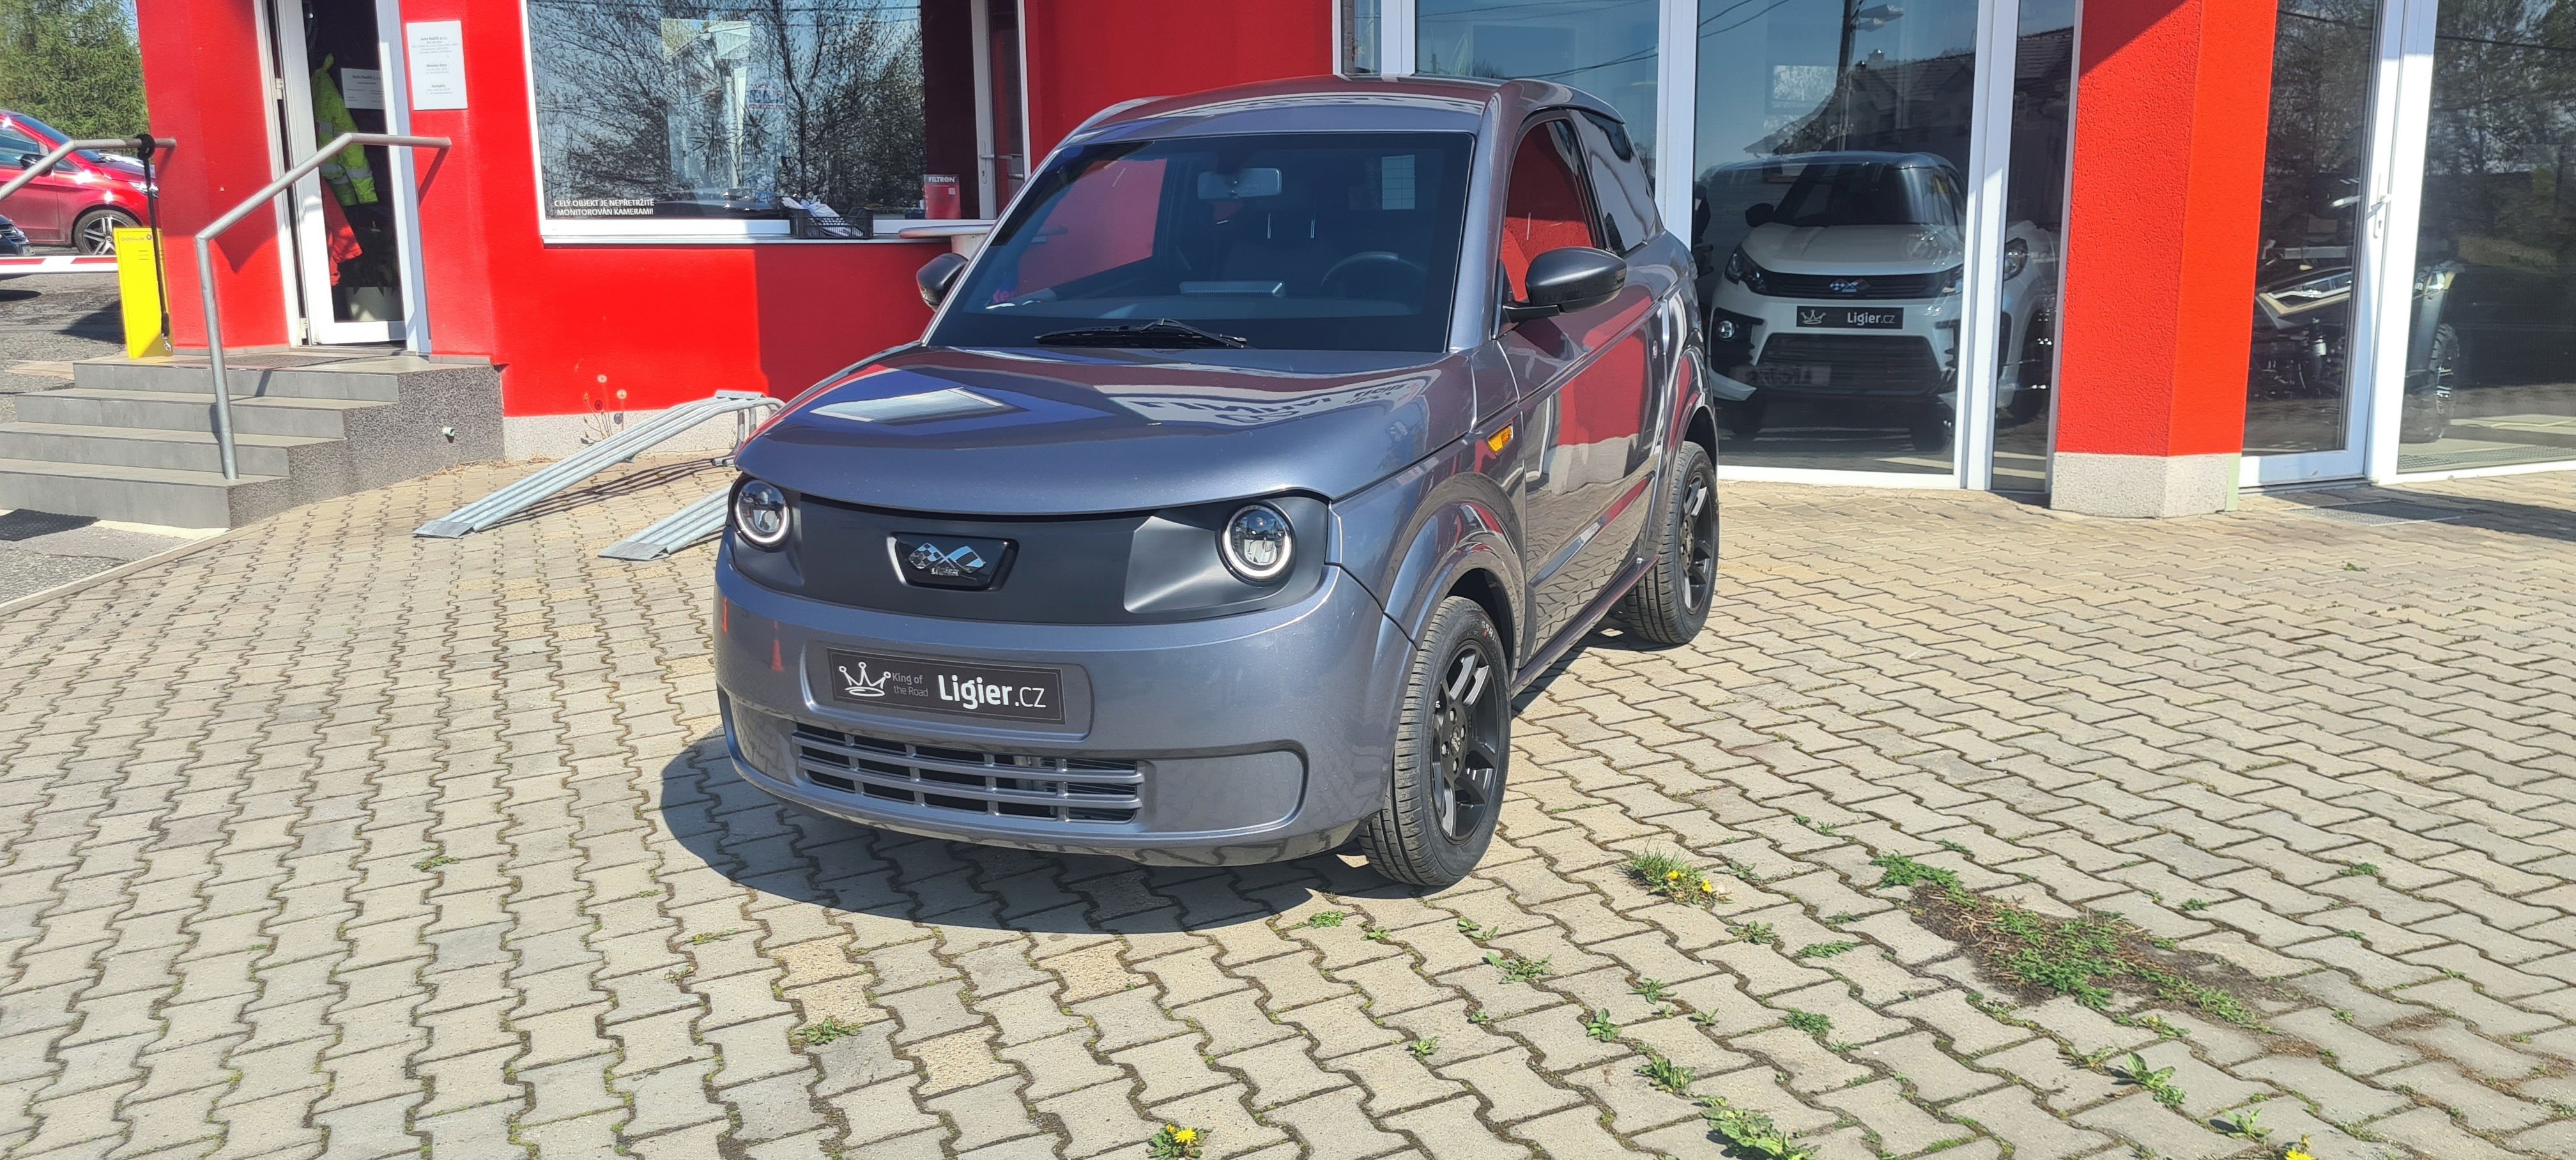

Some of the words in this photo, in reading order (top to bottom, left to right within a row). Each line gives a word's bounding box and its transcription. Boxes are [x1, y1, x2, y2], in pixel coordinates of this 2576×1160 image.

[554, 199, 571, 207] CELÝ
[609, 198, 655, 206] NEPŘETRŽITĚ
[556, 208, 613, 216] MONITOROVÁN
[892, 672, 912, 685] King
[914, 675, 924, 684] of
[894, 685, 907, 695] the
[908, 686, 928, 697] Road
